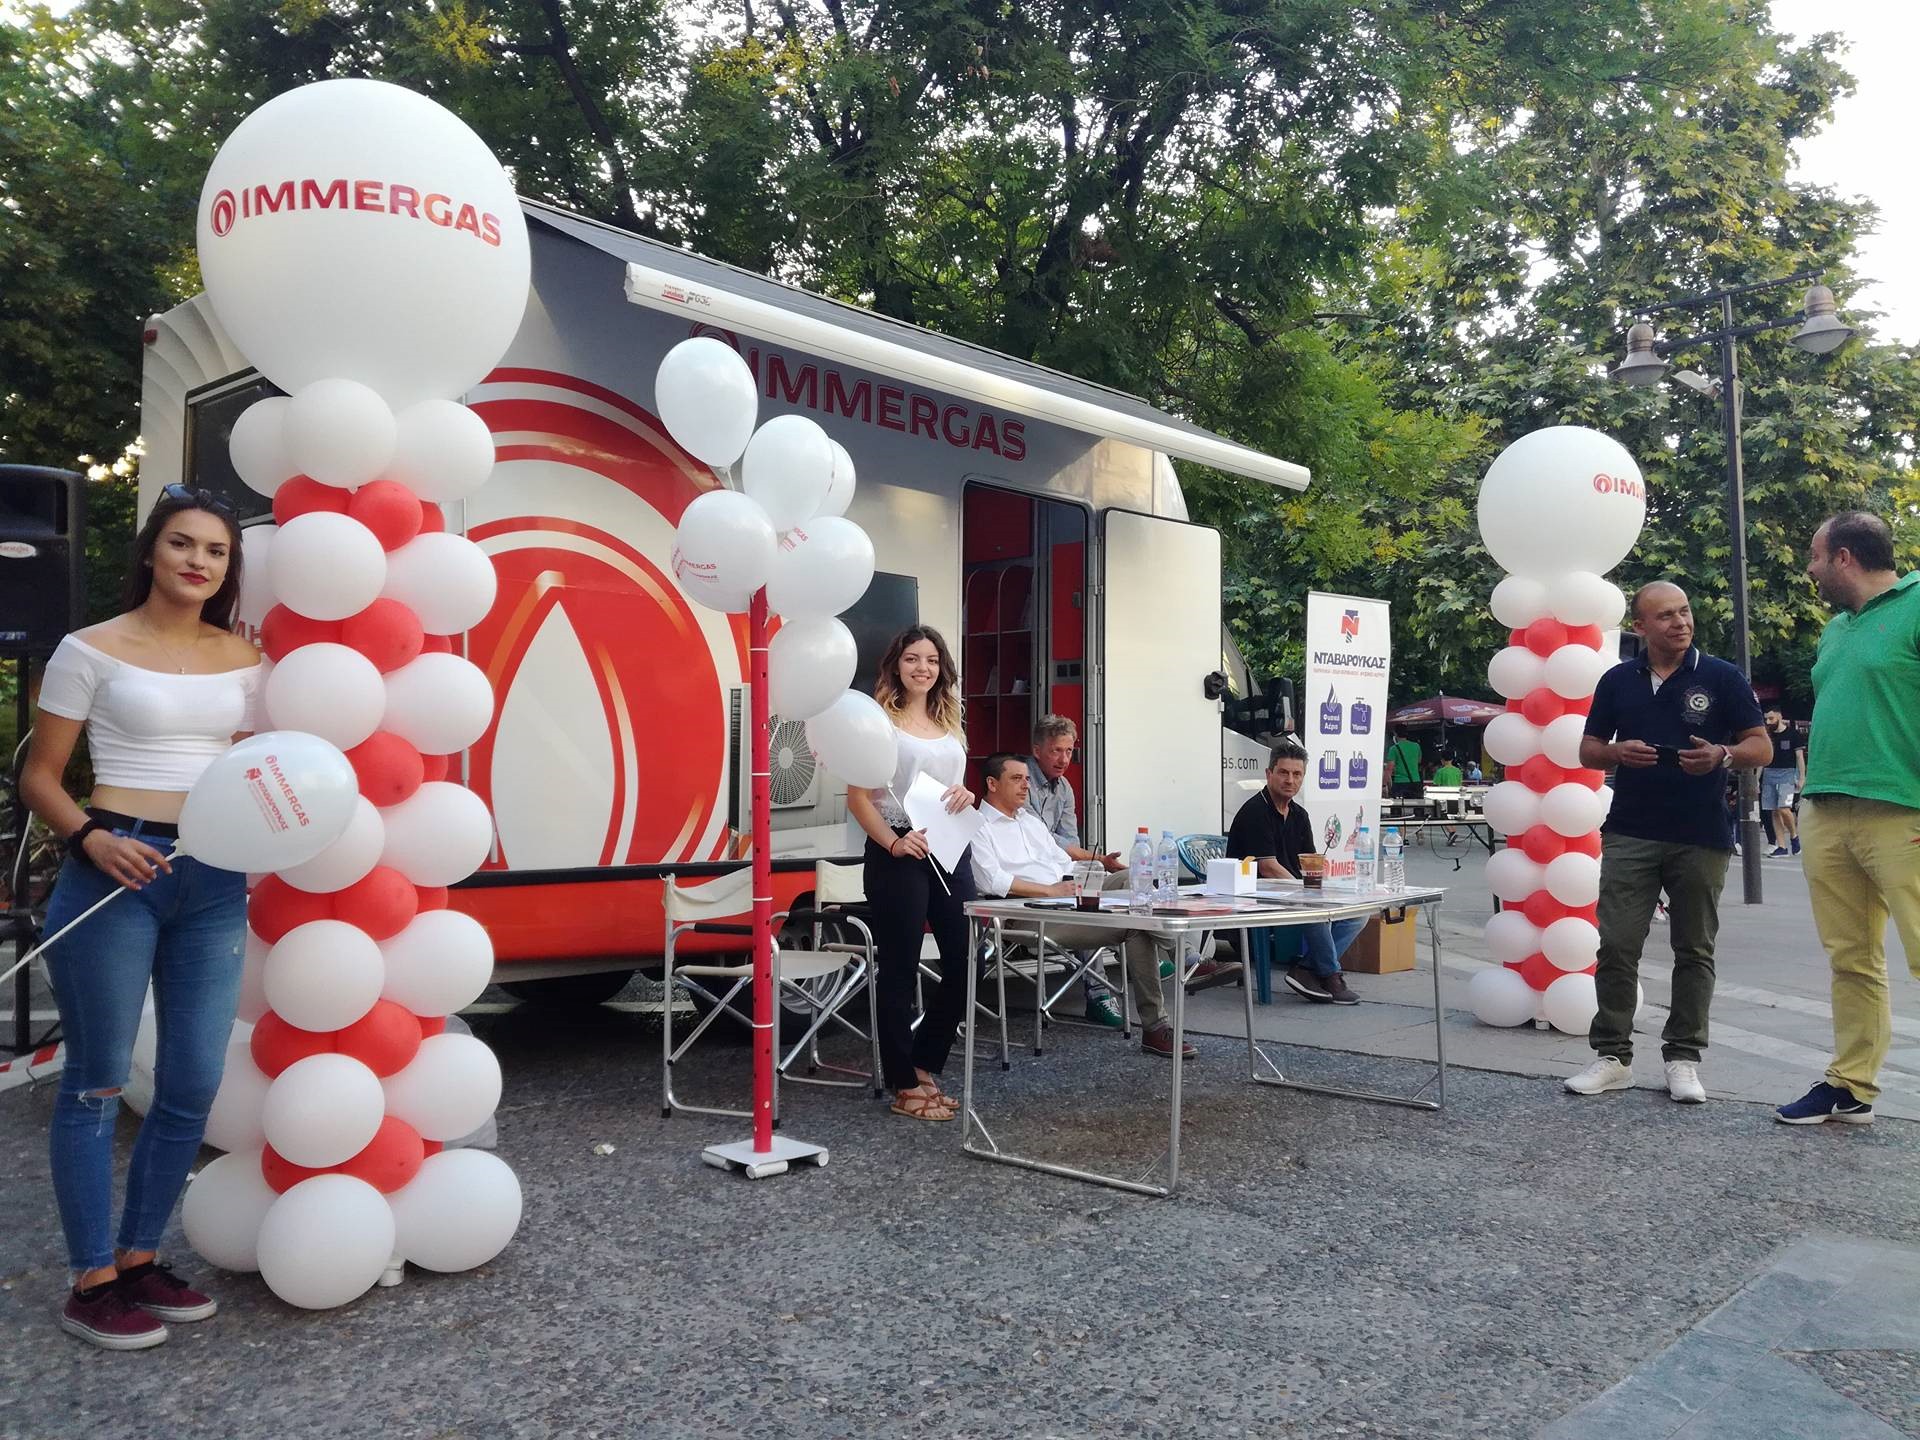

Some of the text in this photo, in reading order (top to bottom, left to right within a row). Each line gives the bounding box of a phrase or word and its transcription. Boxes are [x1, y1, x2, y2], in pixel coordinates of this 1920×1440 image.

[242, 179, 501, 247] IMMERGAS
[749, 347, 1026, 461] IMMERGAS
[1313, 651, 1387, 669] ΝΤΑΒΑΡΟΥΚΑΣ
[269, 763, 310, 827] IMMERGAS
